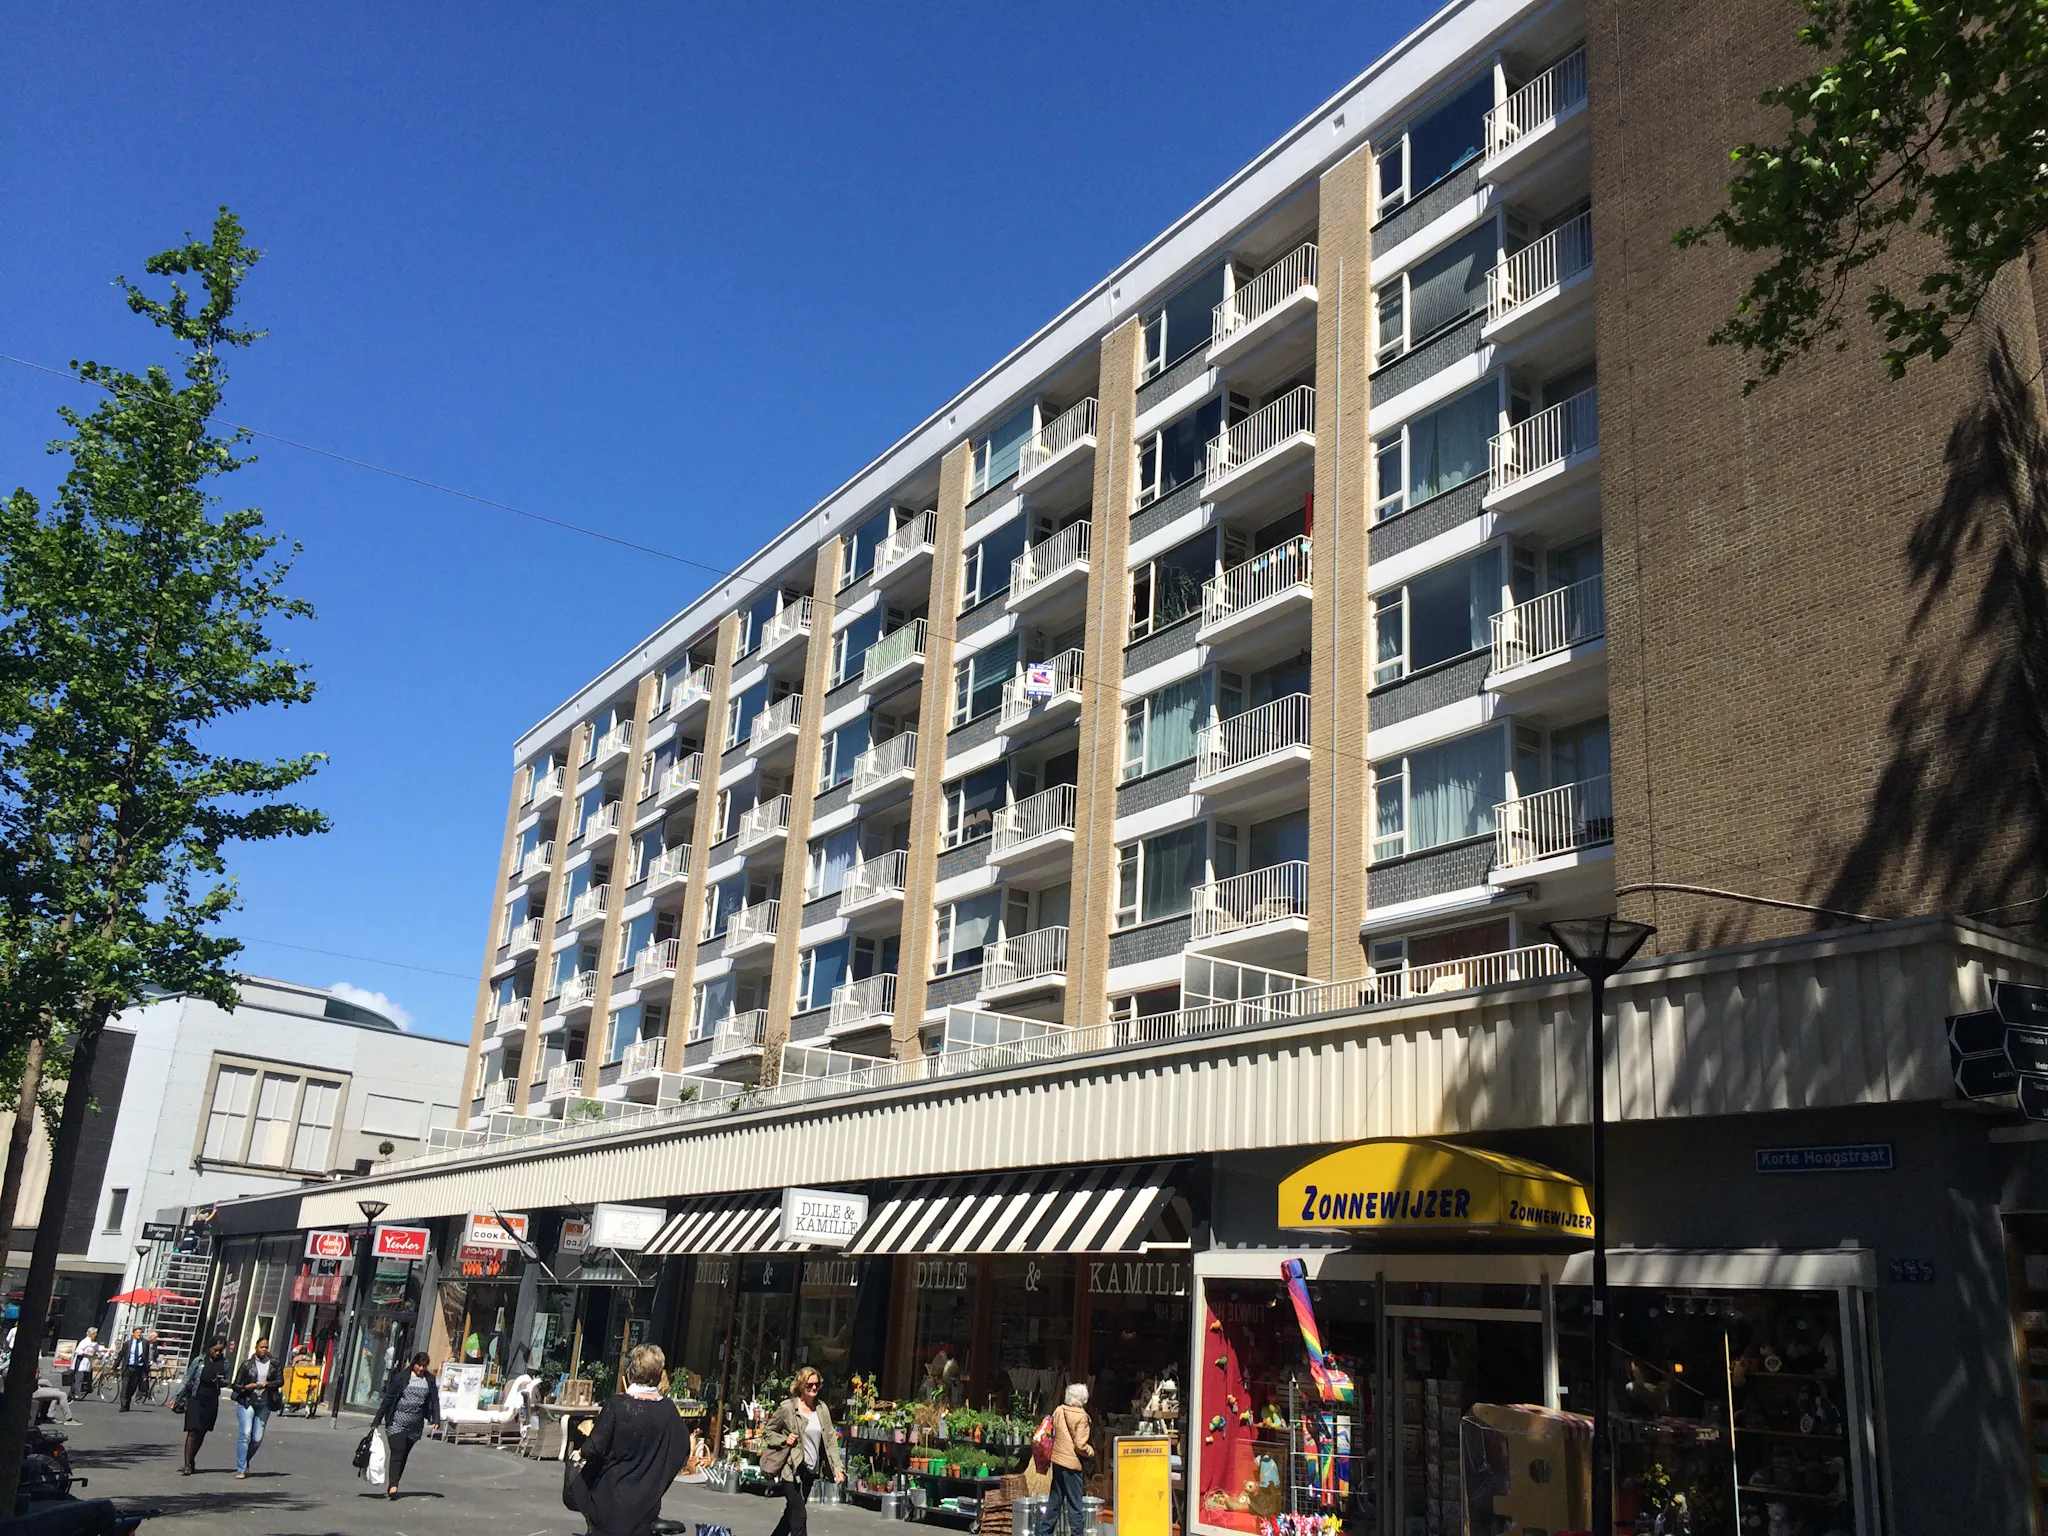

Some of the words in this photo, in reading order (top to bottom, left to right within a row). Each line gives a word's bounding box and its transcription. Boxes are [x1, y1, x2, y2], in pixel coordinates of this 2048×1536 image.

[1761, 1152, 1799, 1165] Korte
[1804, 1148, 1885, 1168] Hoogstraat
[800, 1201, 841, 1219] DILLE
[844, 1205, 856, 1220] &
[1301, 1185, 1471, 1221] ZONNEWIJZER
[1509, 1200, 1592, 1230] ZONNEWIJZER
[795, 1216, 859, 1236] KAMILLE
[323, 1235, 342, 1248] daily
[385, 1236, 420, 1250] Yendor
[695, 1261, 730, 1285] DILLE
[762, 1261, 774, 1286] &
[801, 1261, 864, 1286] KAMILL
[915, 1261, 968, 1290] DILLE
[1025, 1261, 1041, 1292] &
[1088, 1262, 1190, 1296] KAMILL
